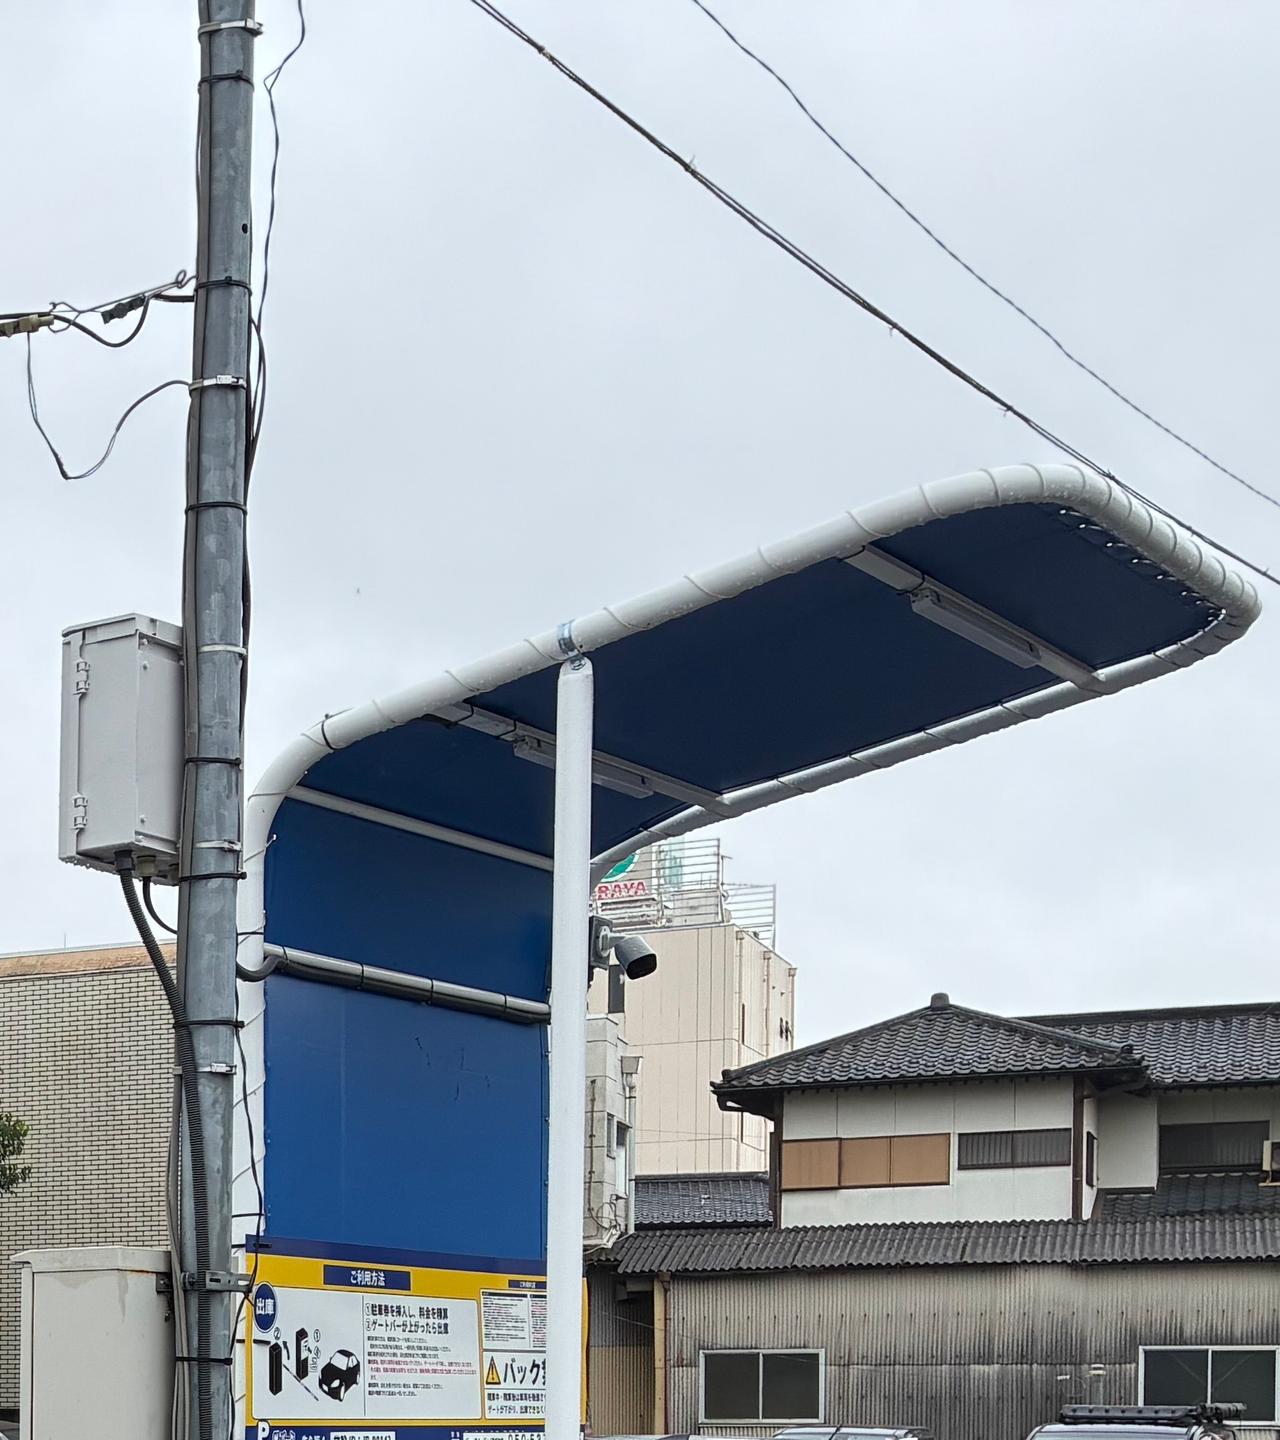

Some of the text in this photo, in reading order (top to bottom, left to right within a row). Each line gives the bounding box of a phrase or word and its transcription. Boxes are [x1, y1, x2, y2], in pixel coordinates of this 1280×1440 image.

[351, 1270, 385, 1286] ご利用方法
[256, 1299, 275, 1315] 出庫
